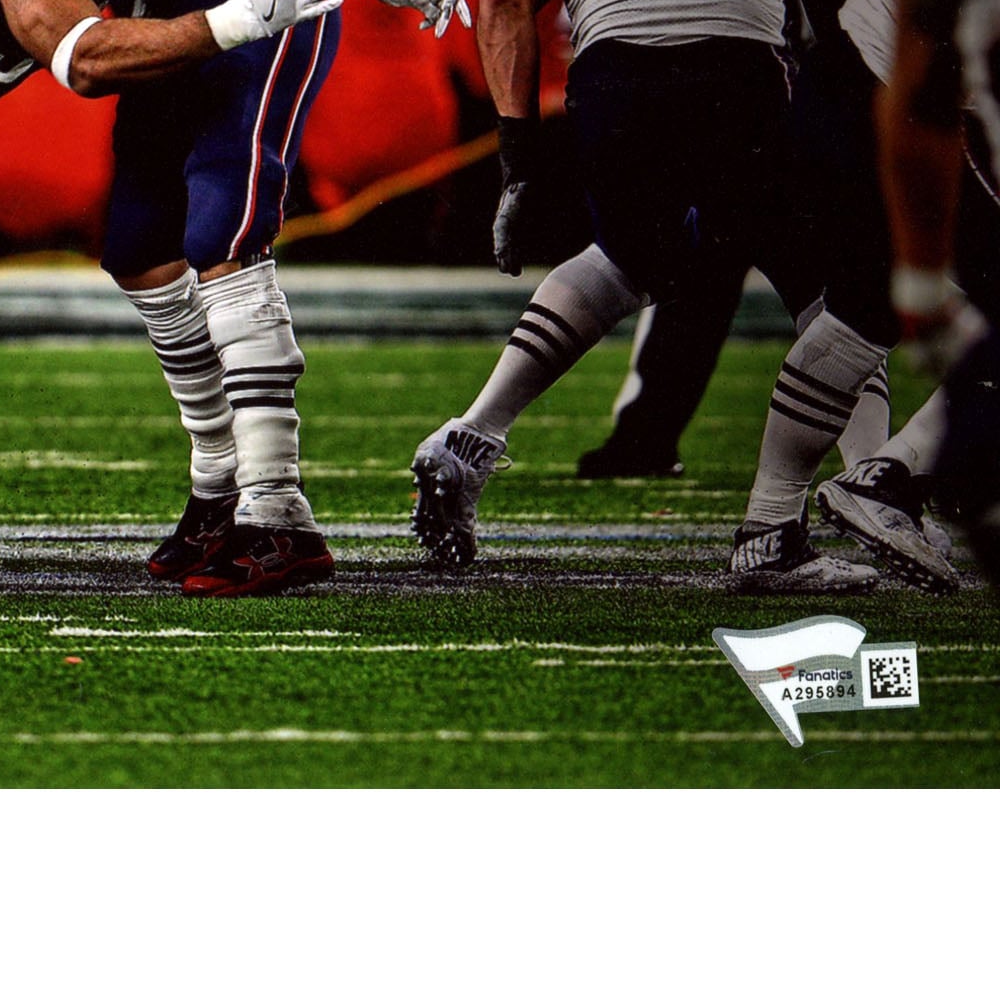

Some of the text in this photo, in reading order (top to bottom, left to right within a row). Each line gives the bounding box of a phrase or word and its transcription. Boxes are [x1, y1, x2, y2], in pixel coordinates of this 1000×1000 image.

[445, 430, 499, 470] NIKE
[798, 667, 853, 682] Fanatics
[782, 684, 856, 701] A295894
